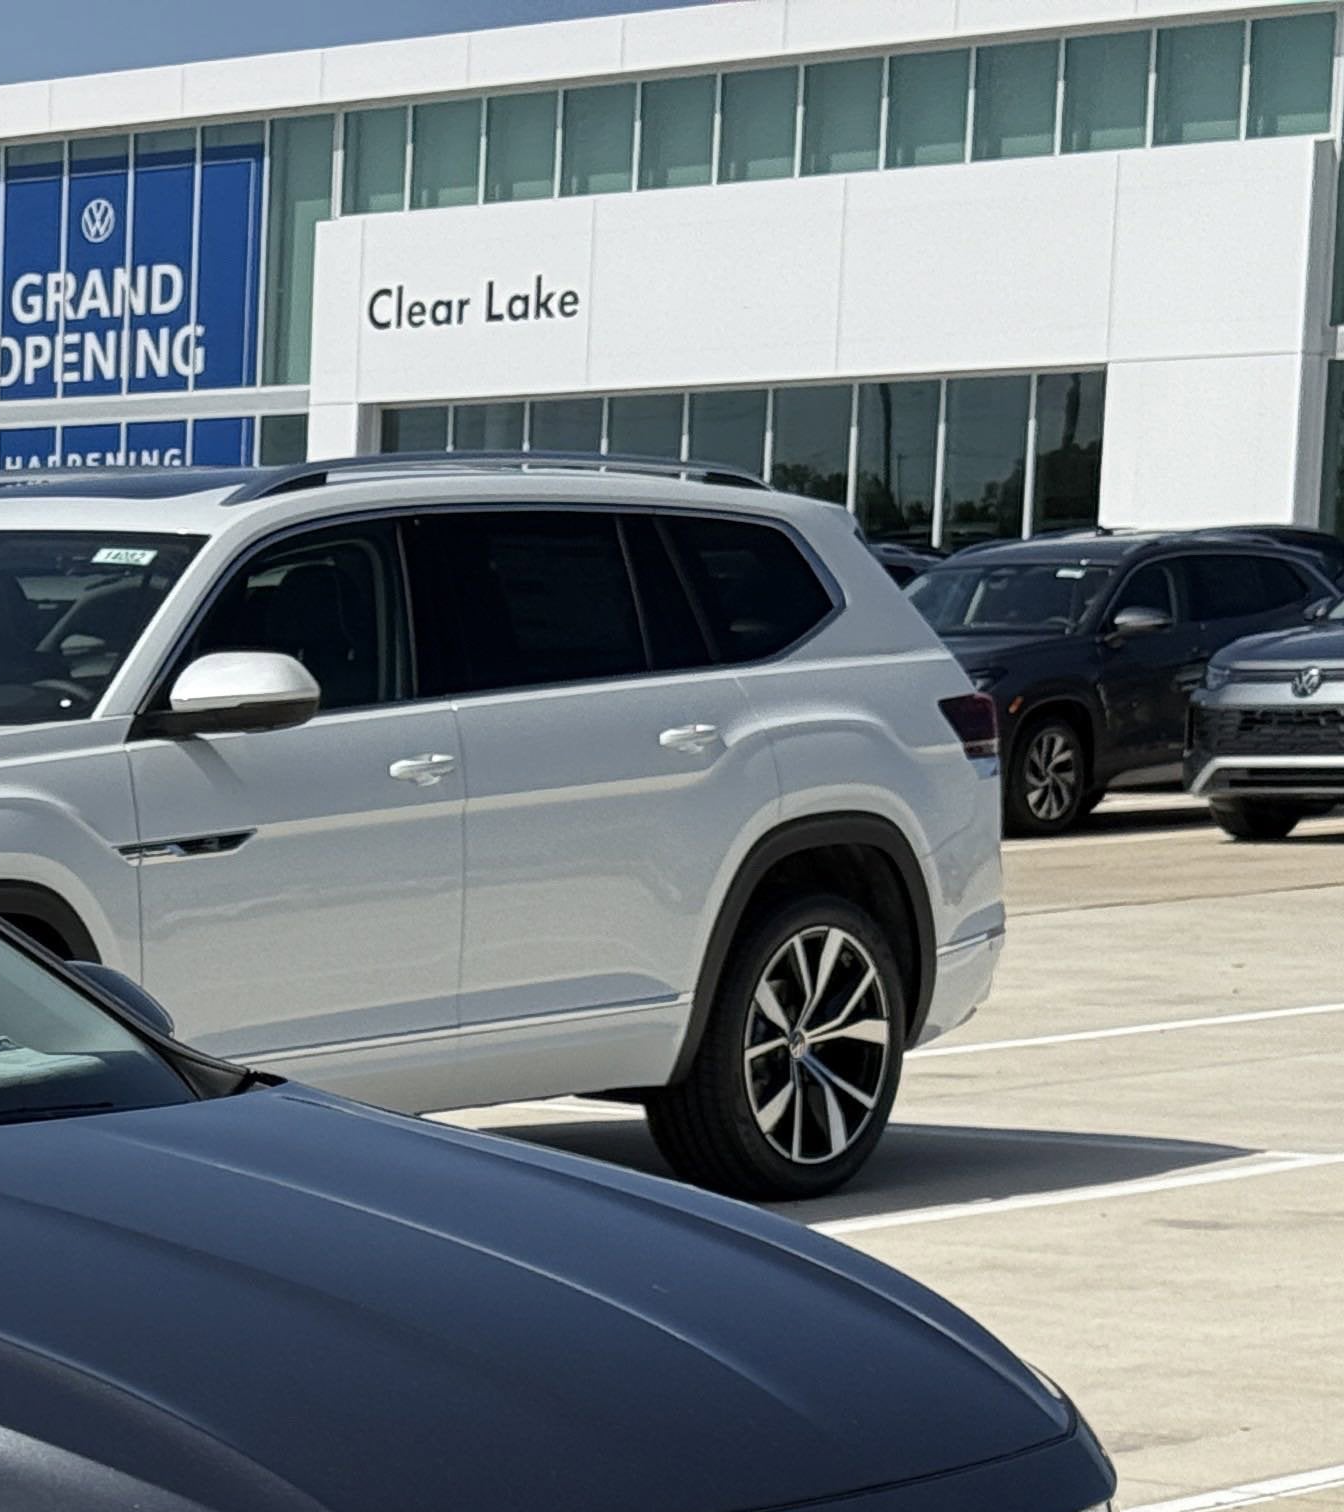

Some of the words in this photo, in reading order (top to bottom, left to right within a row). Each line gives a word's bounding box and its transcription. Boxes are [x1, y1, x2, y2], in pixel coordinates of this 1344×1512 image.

[82, 199, 115, 243] VW
[11, 264, 184, 324] GRAND
[368, 285, 471, 330] Clear
[485, 274, 580, 322] Lake
